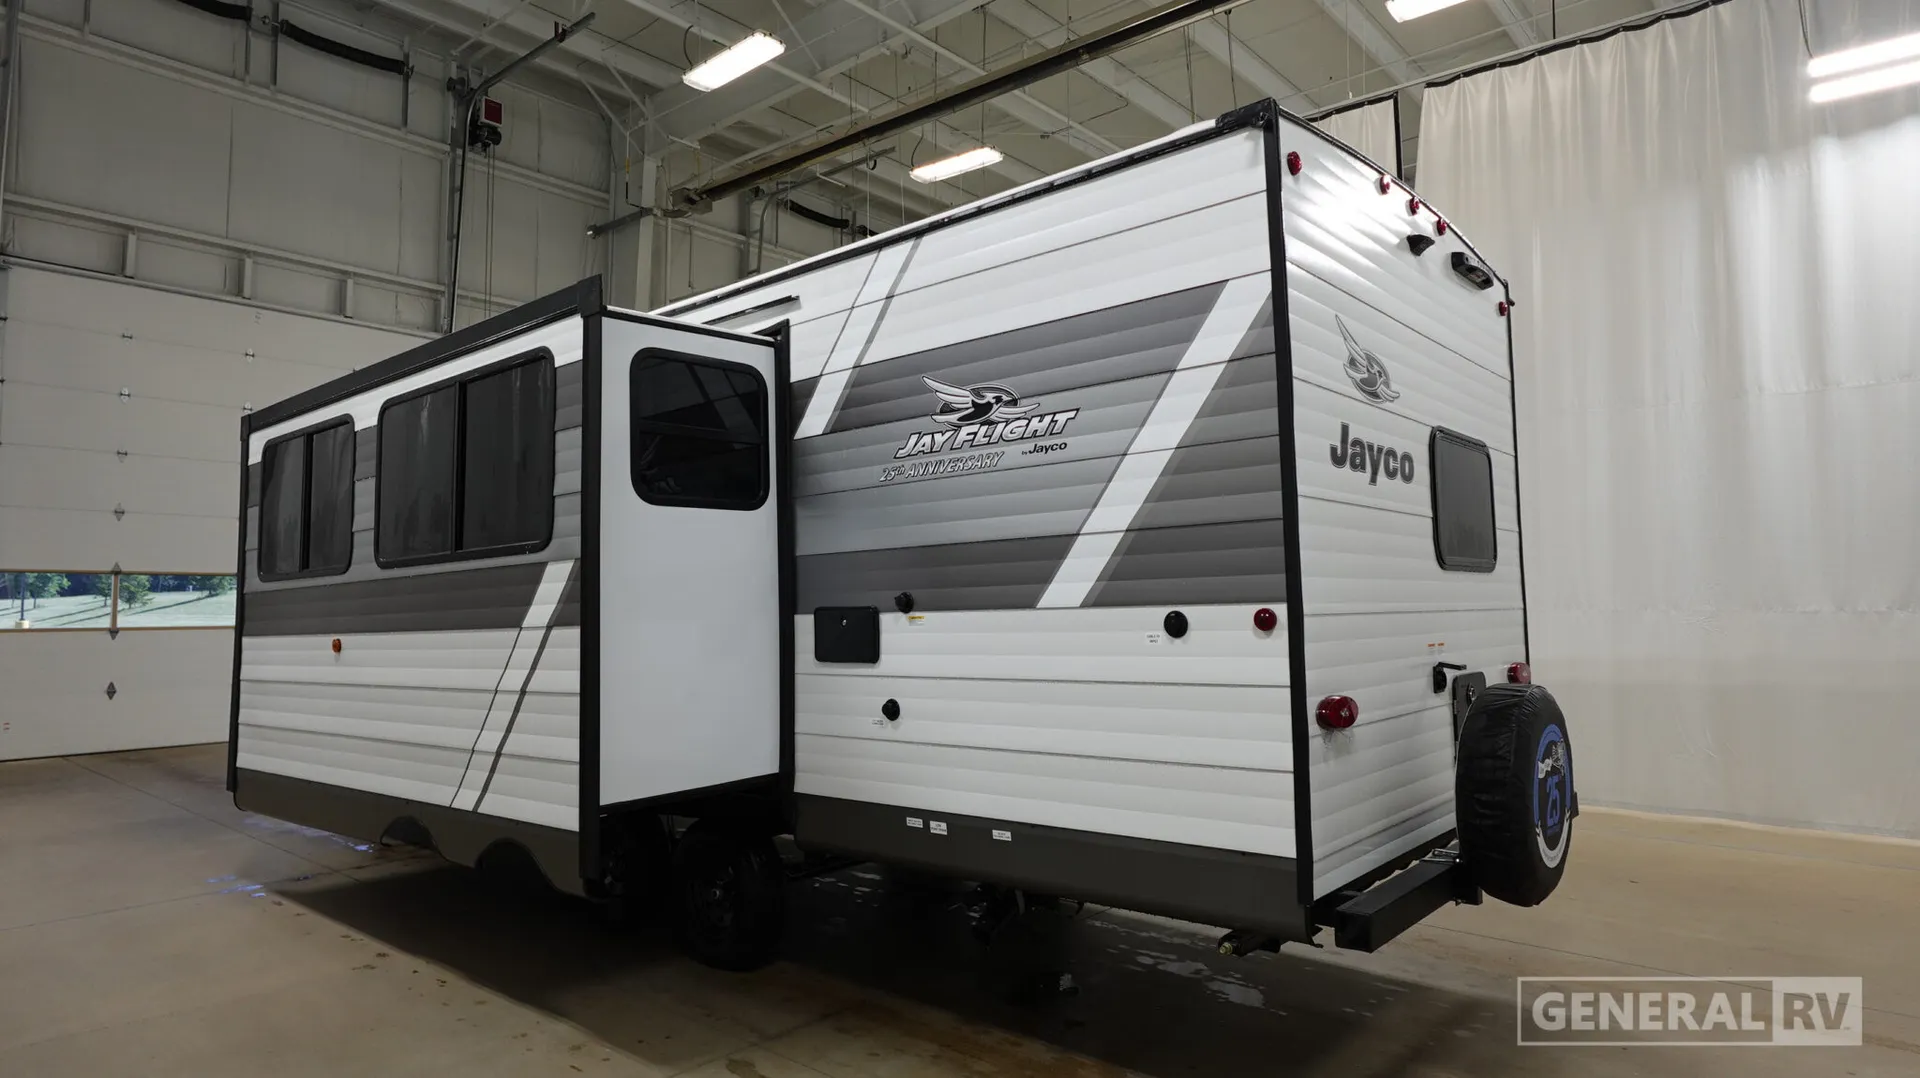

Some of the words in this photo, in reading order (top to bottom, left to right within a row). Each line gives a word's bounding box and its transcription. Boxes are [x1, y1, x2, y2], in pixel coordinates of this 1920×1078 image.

[894, 429, 957, 459] JAY
[951, 407, 1081, 450] FLIGHT
[1028, 442, 1068, 455] Jayco
[1329, 421, 1415, 486] Jayco
[879, 464, 906, 482] 25th
[905, 451, 1005, 479] ANNIVERSARY
